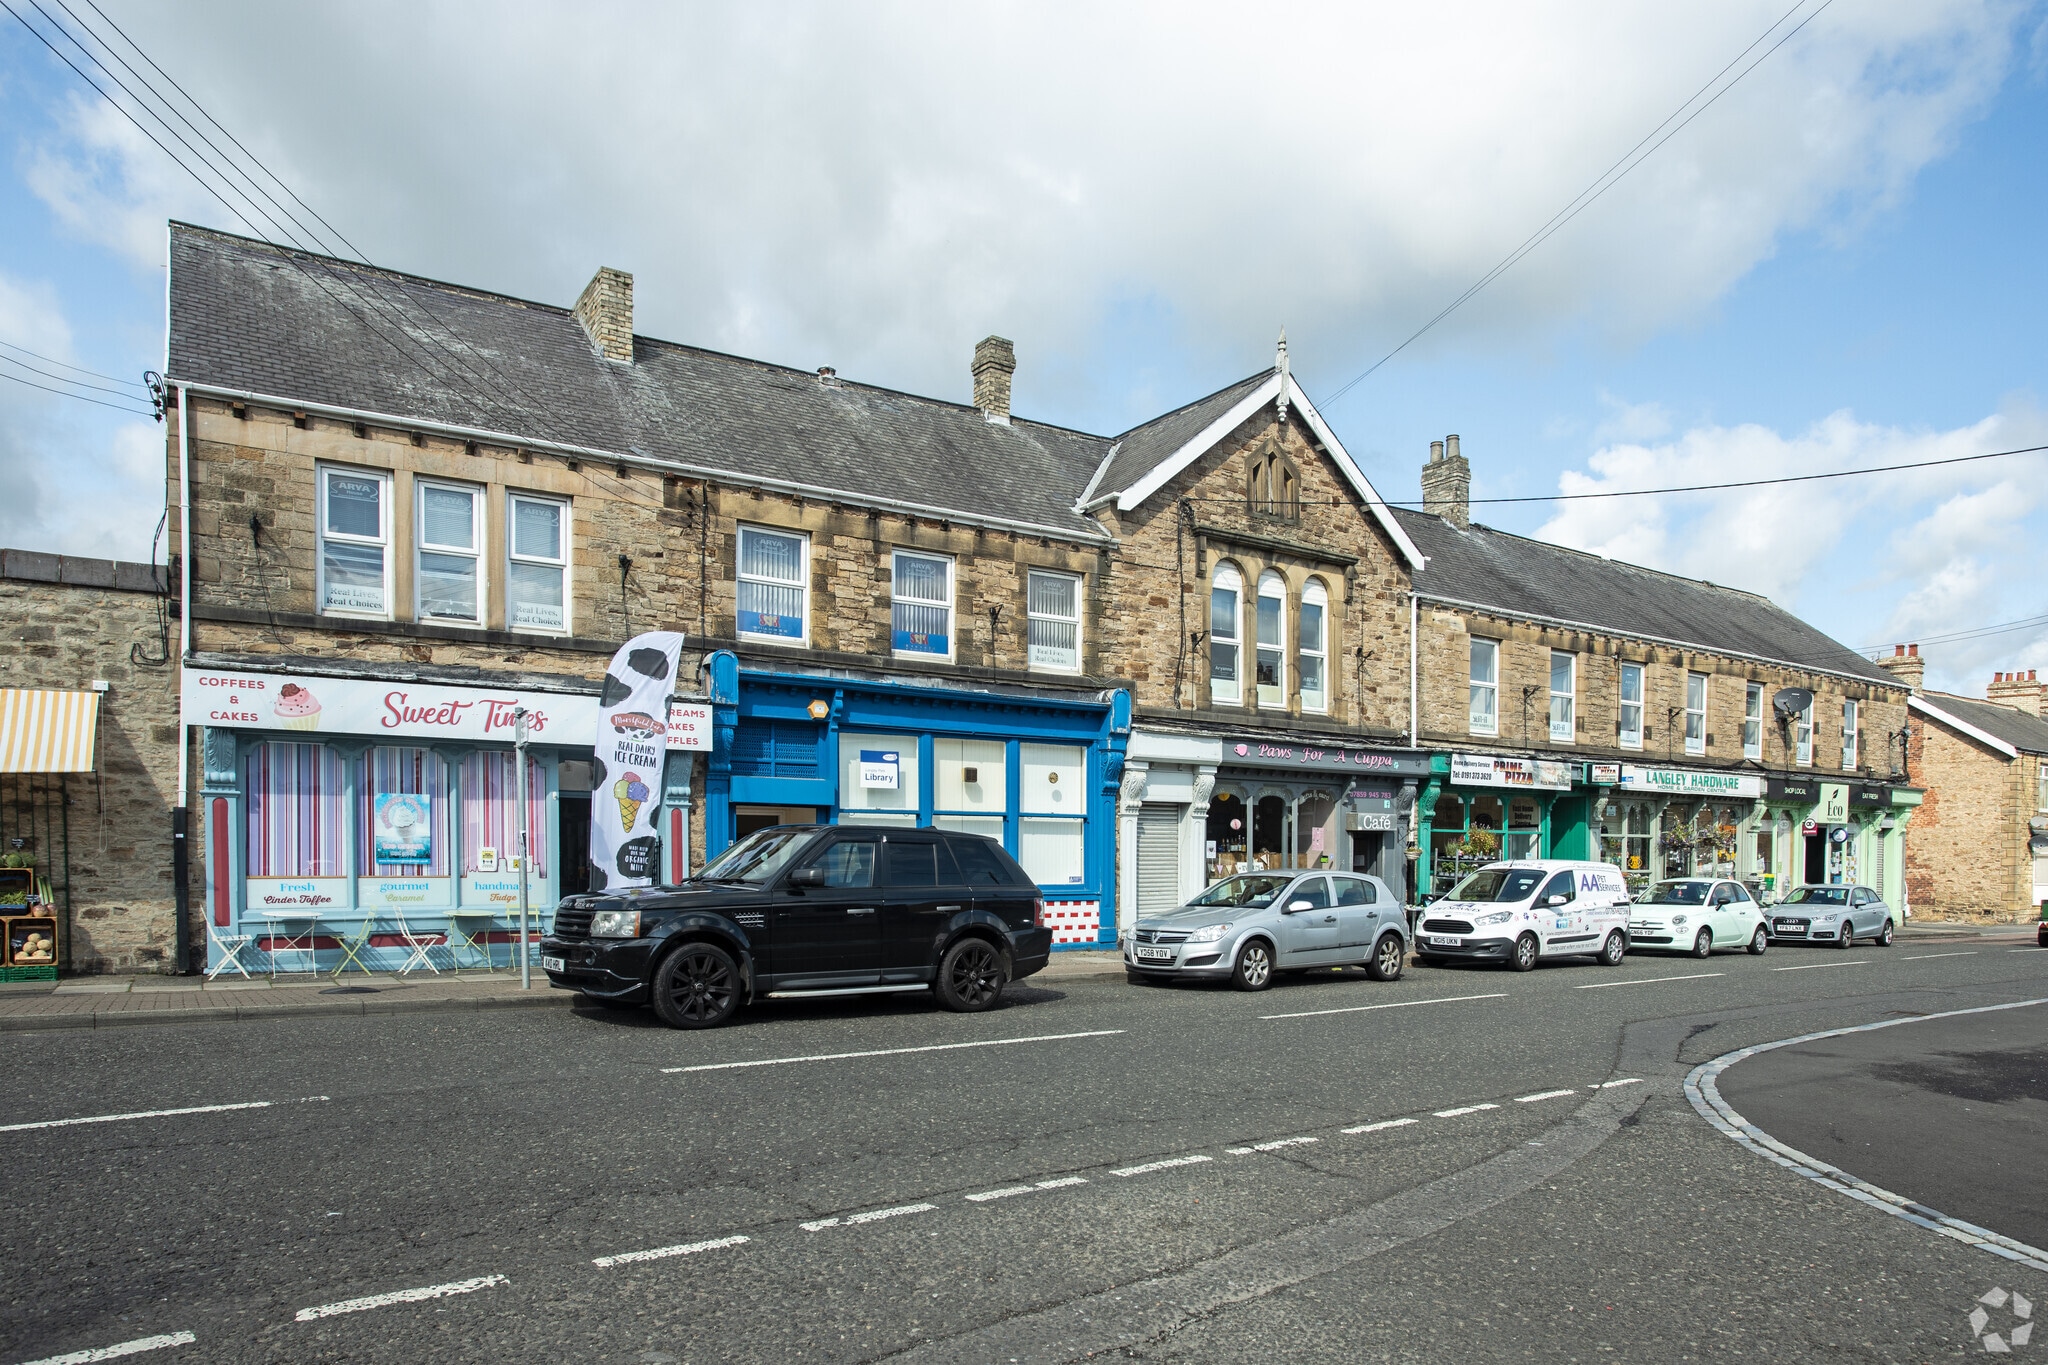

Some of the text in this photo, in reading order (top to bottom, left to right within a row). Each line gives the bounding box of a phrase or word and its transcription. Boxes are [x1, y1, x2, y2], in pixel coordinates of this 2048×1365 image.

[338, 482, 371, 492] ARYA
[760, 538, 782, 547] ARYA
[330, 587, 350, 596] Real
[326, 596, 383, 609] Real Choices
[516, 605, 558, 617] Real Lives,
[512, 614, 562, 626] Real Choices
[198, 676, 266, 690] COFFEES
[229, 695, 239, 705] &
[381, 691, 474, 728] Sweet
[669, 708, 706, 718] REAMS
[210, 710, 259, 722] CAKES
[668, 722, 695, 731] AKES
[667, 736, 699, 746] FFLES
[618, 740, 656, 756] REAL DAIRY
[614, 750, 657, 768] ICE CREAM
[1258, 743, 1393, 769] Paws For A Cuppa
[1493, 760, 1523, 772] PRIME
[865, 773, 893, 783] Library
[1461, 771, 1472, 779] 0191
[1504, 771, 1534, 785] PIZZA
[1646, 771, 1739, 789] LANGLEY HARDWARE
[1368, 791, 1379, 799] 945
[1381, 791, 1392, 799] 783
[1827, 800, 1843, 817] Eco
[1363, 813, 1391, 830] Café
[624, 855, 649, 864] ORGANIC
[630, 863, 643, 872] MILK
[1580, 873, 1600, 892] AA
[1597, 874, 1606, 882] PET
[280, 882, 315, 892] Fresh
[379, 882, 430, 893] gourmet
[474, 881, 532, 890] handmae
[1599, 883, 1621, 892] SERVICES
[264, 894, 332, 906] Cinder Toffee
[385, 893, 425, 902] Caramel
[489, 893, 517, 903] Fudge
